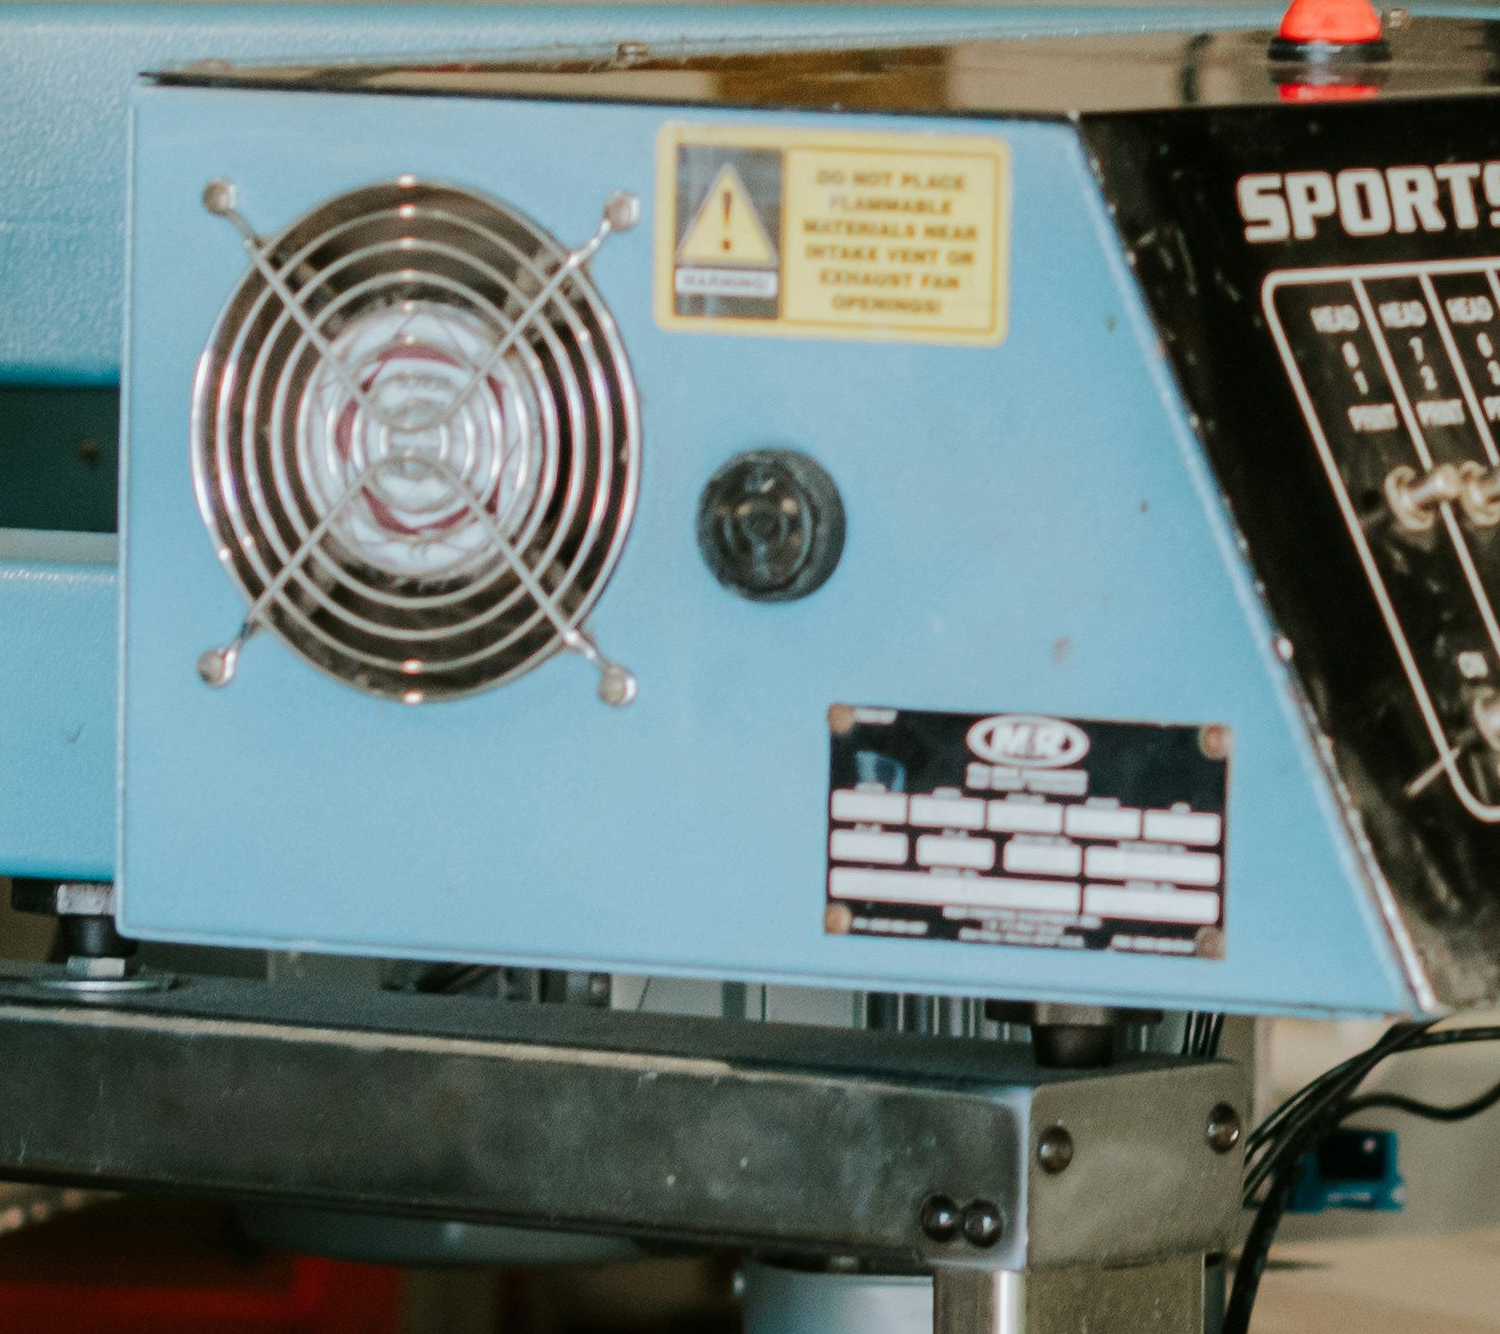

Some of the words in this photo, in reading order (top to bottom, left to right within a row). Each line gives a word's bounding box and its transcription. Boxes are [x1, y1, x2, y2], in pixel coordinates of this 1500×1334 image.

[852, 170, 893, 188] NOT
[901, 172, 965, 192] PLACE
[830, 194, 951, 217] FLAMMABLE
[803, 218, 916, 239] MATERIALS
[923, 224, 978, 242] NEAR
[805, 243, 878, 262] INTAKE
[887, 247, 938, 264] VENT
[819, 268, 913, 287] EXHAUST
[1310, 304, 1360, 334] HEAD
[1378, 300, 1427, 329] HEAD
[1445, 295, 1494, 324] HEAD
[1409, 336, 1424, 362] 7
[1420, 365, 1438, 391] 2
[1348, 403, 1398, 433] PRINT
[1416, 398, 1465, 427] PRINT
[1457, 651, 1489, 679] ON
